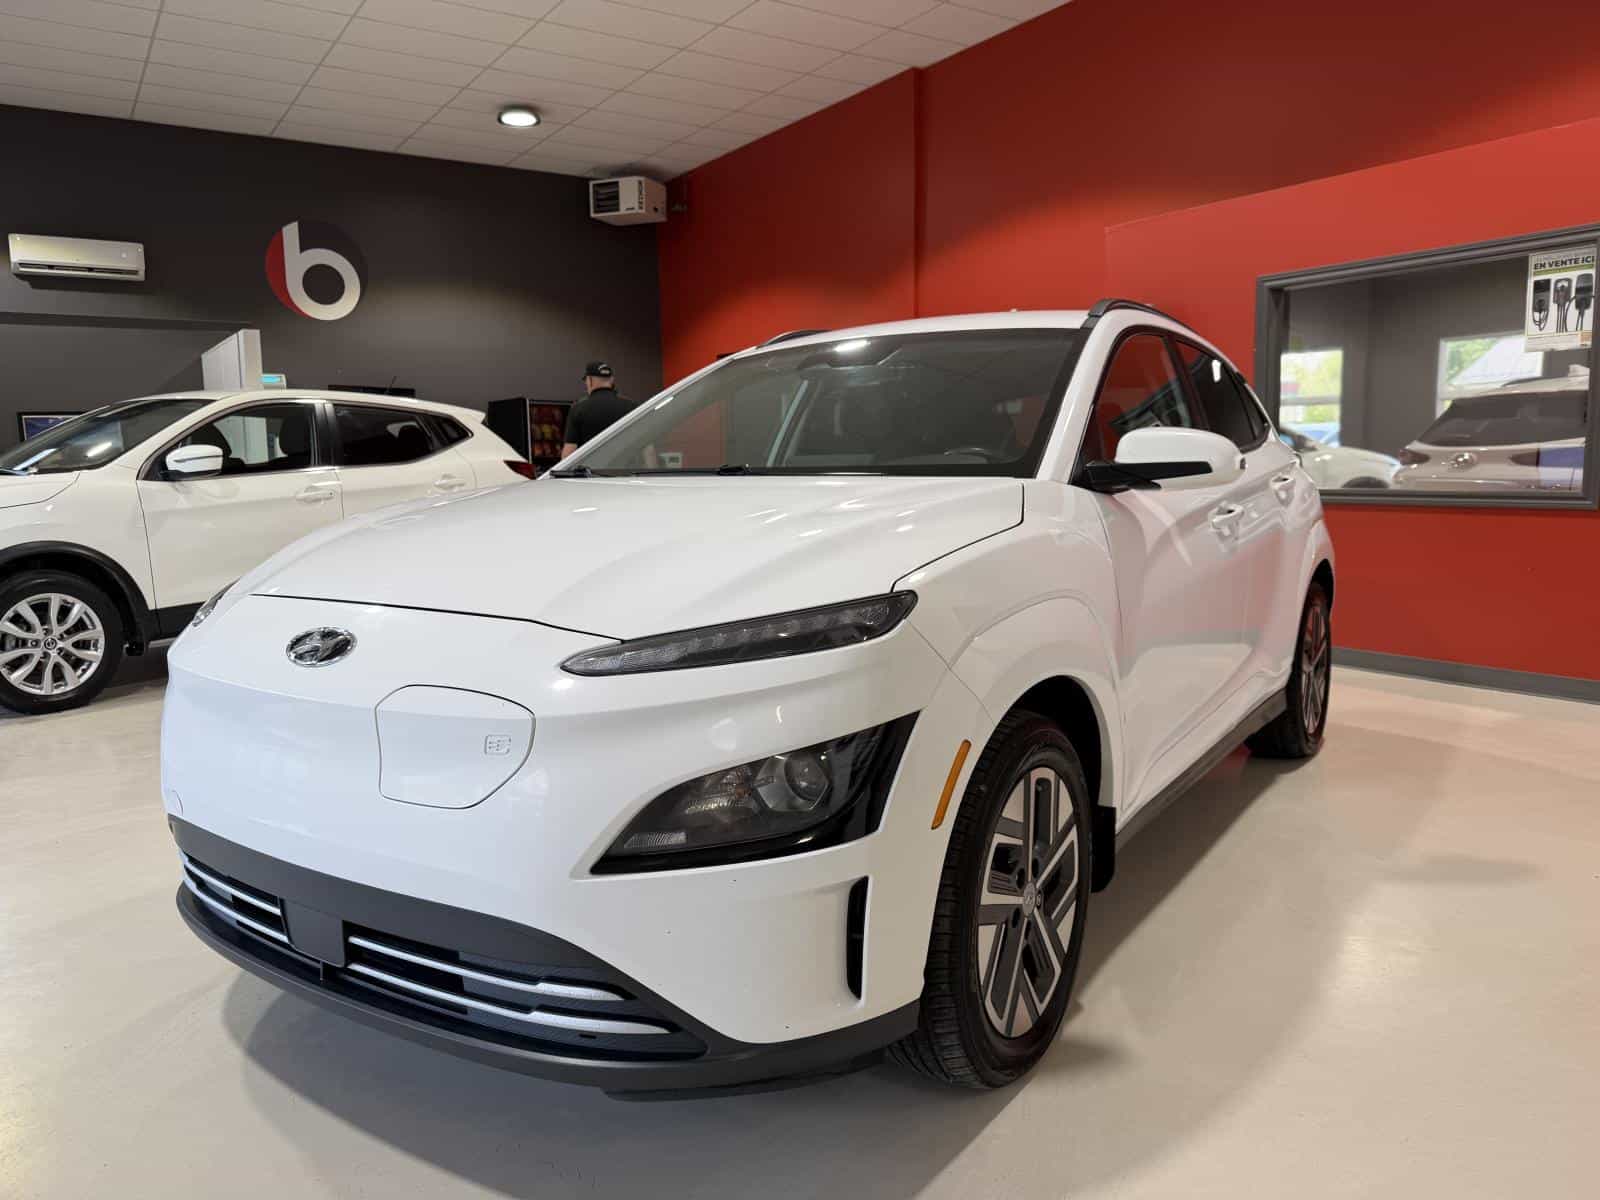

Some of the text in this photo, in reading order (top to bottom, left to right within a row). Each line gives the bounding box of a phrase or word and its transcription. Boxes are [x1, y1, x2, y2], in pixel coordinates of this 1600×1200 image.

[282, 220, 361, 321] b
[1534, 262, 1547, 270] EN
[1548, 257, 1581, 268] VENTE
[1582, 255, 1595, 264] ICI
